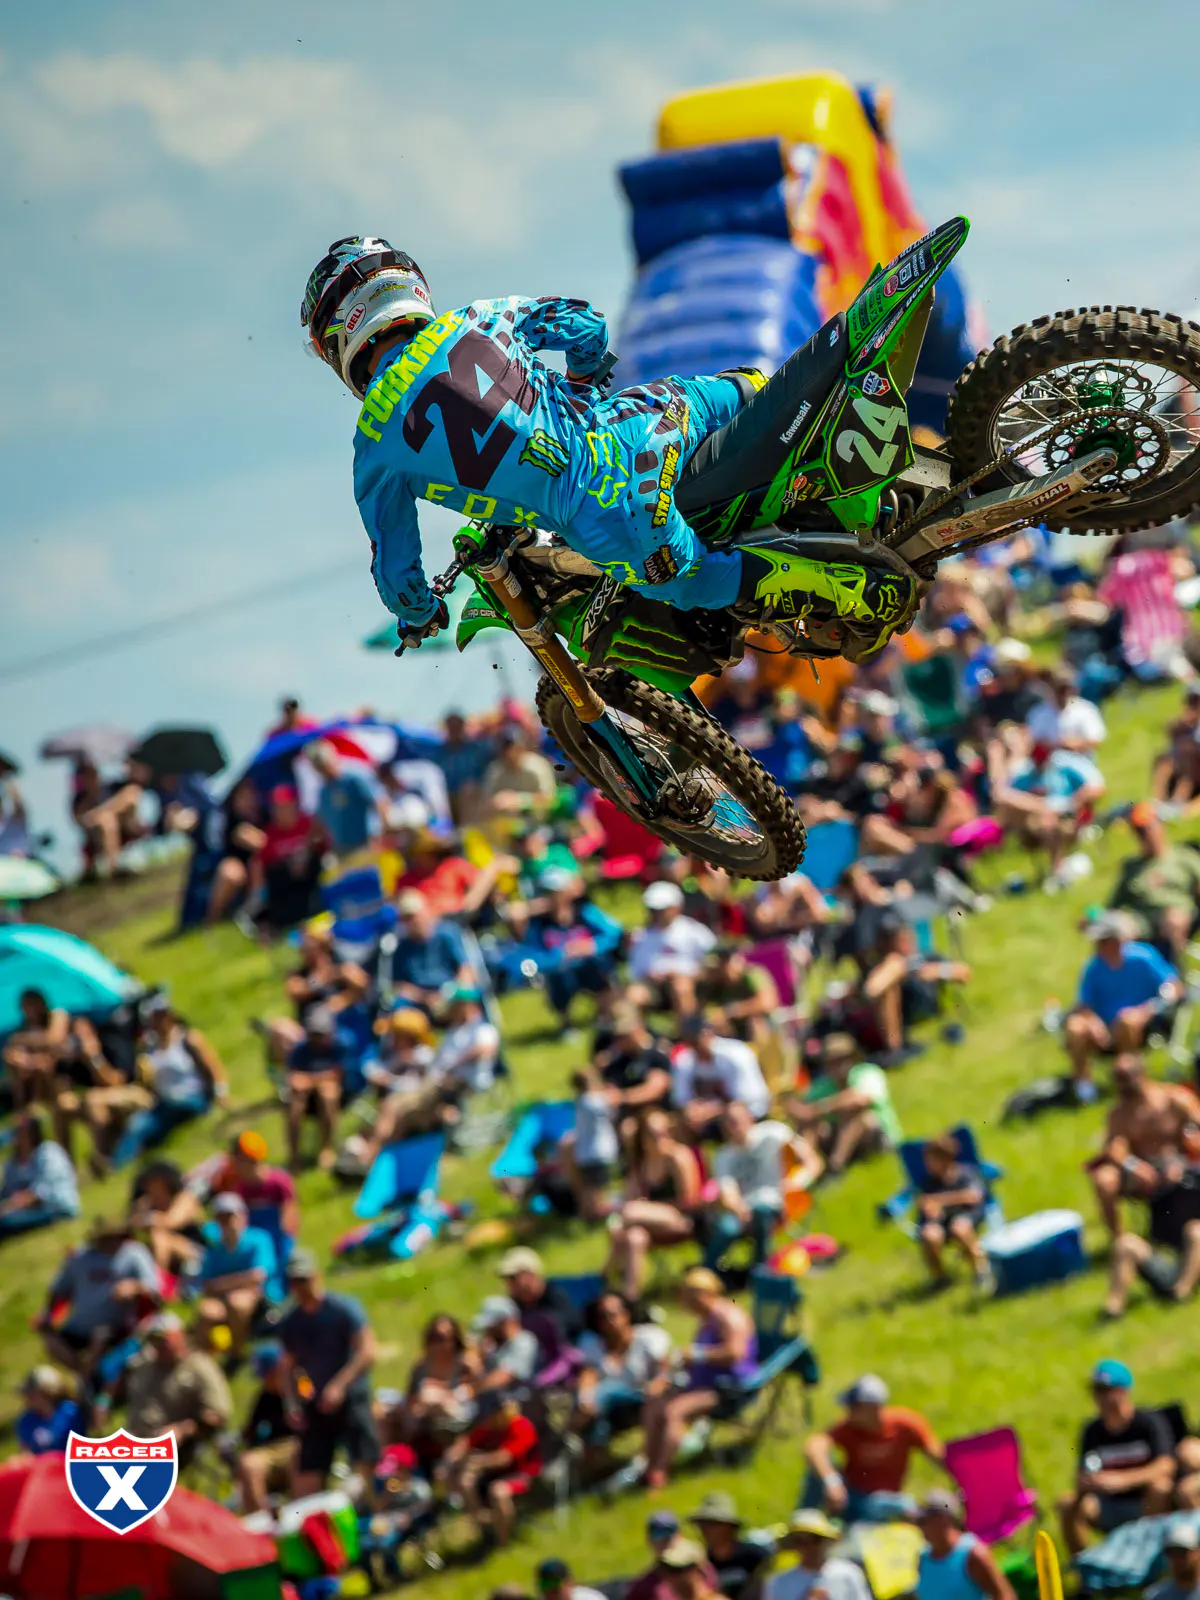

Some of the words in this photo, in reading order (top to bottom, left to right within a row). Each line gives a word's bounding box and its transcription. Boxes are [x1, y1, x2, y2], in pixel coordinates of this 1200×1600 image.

[346, 308, 364, 331] BELL
[356, 310, 465, 443] FORKNER
[402, 328, 541, 491] 24
[780, 400, 812, 445] Kawasaki
[836, 396, 907, 476] 24
[660, 445, 679, 490] SAVAGE
[424, 482, 541, 529] FOX
